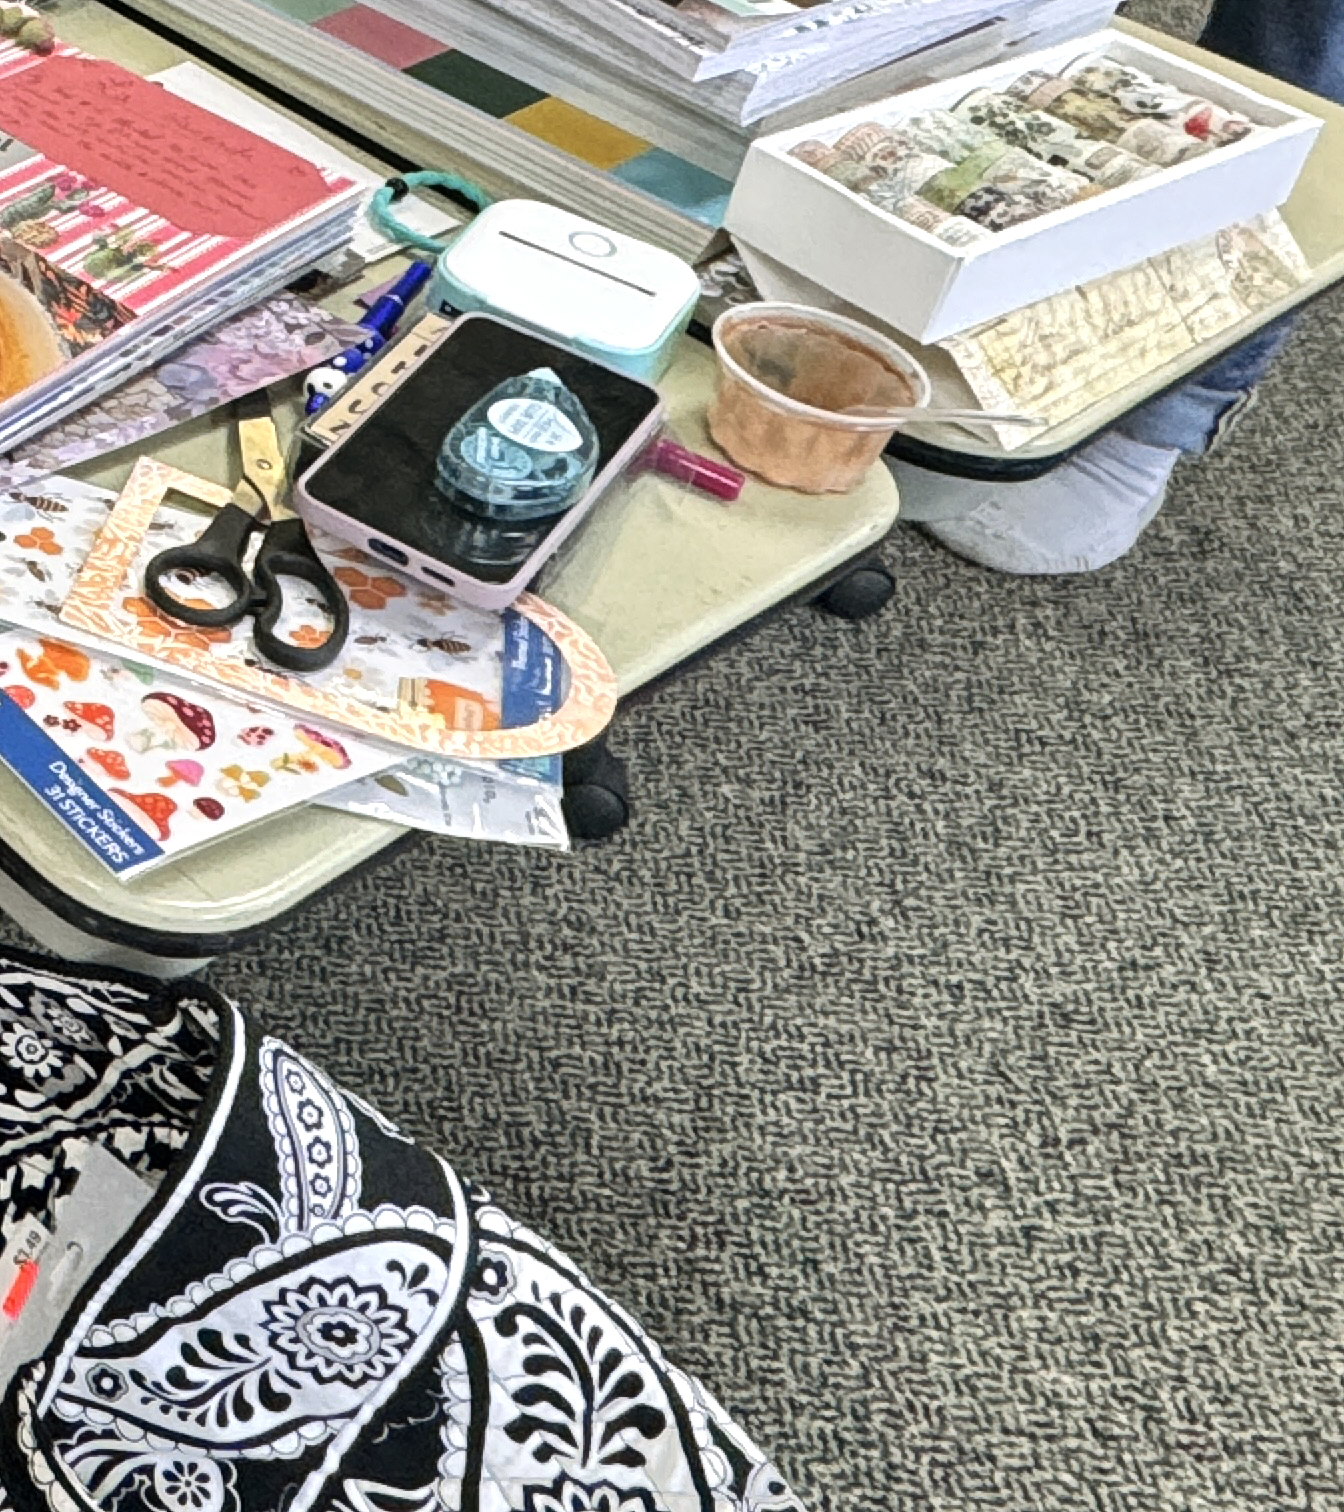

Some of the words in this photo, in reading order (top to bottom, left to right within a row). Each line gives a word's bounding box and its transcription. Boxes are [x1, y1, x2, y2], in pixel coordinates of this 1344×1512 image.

[48, 761, 102, 810] Designer
[95, 807, 146, 856] Stickers
[59, 799, 130, 864] STICKERS
